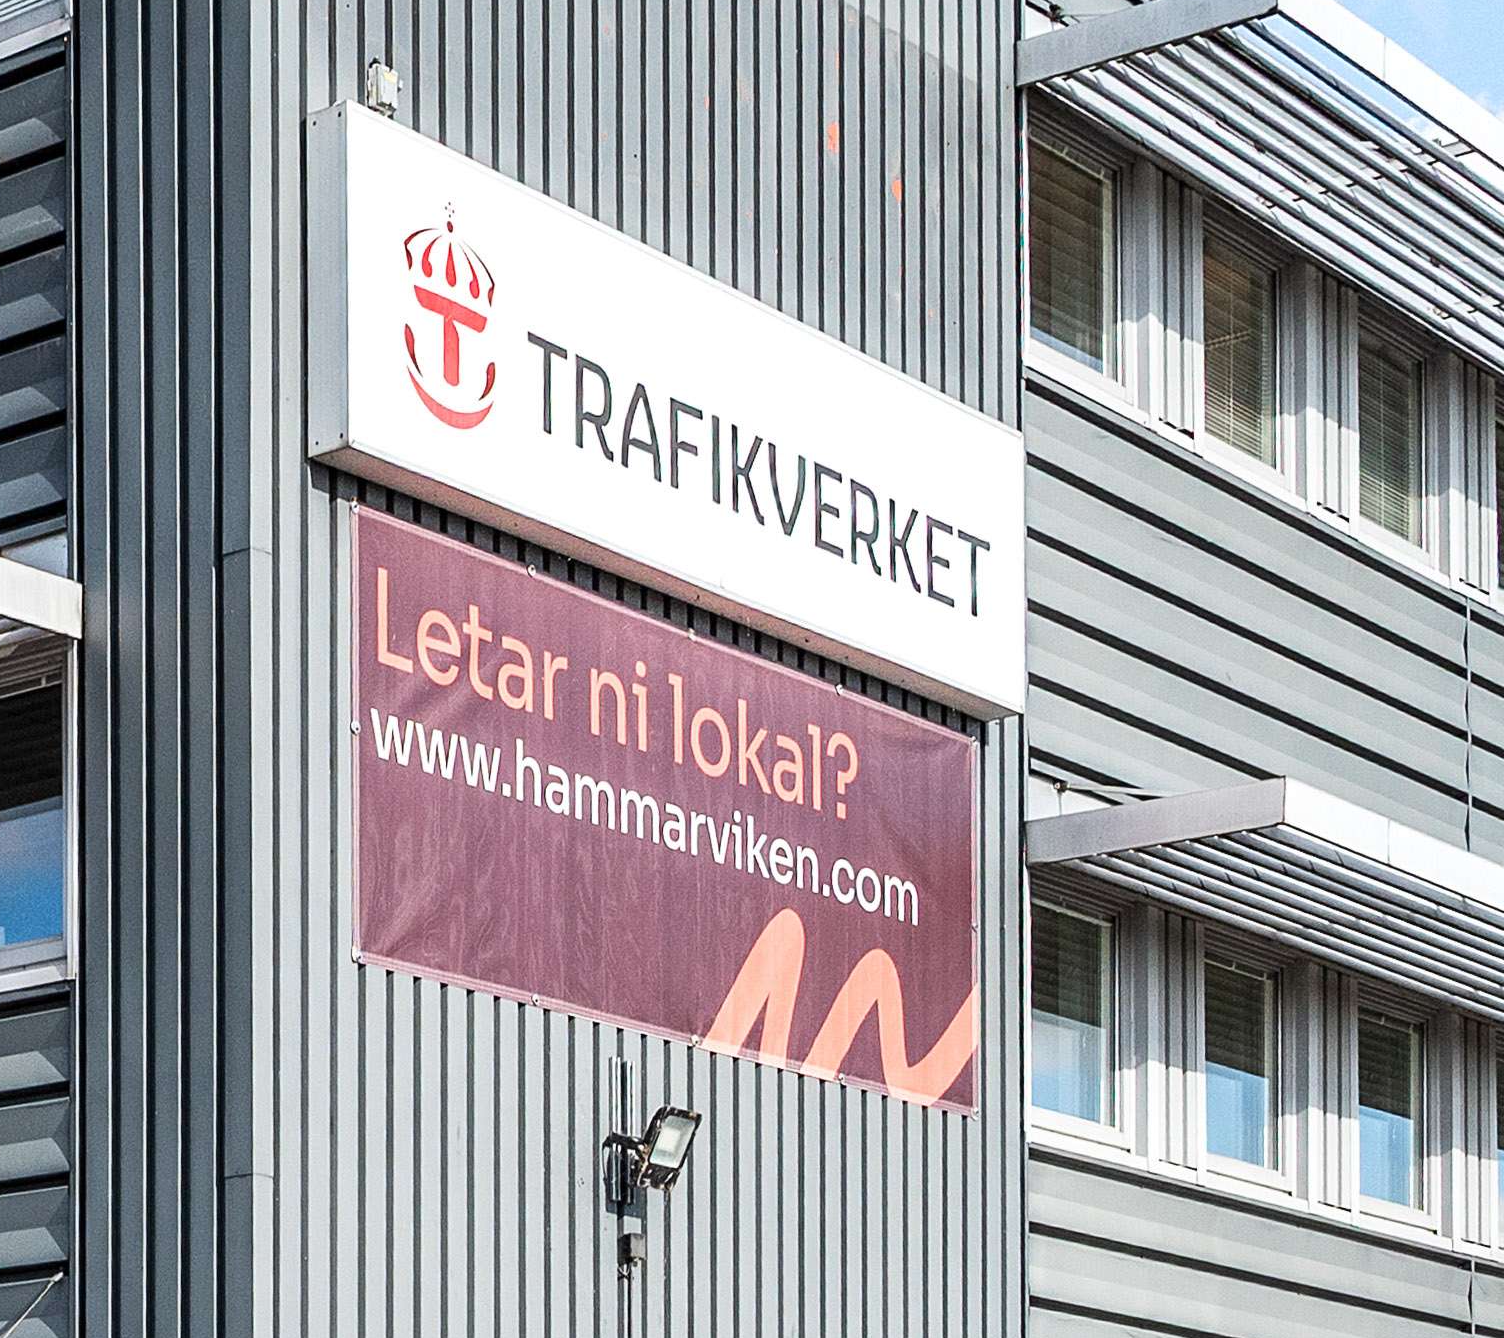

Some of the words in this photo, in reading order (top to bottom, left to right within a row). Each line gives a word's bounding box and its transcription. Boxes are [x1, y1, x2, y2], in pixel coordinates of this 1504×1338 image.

[527, 330, 991, 617] TRAFIKVERKET
[369, 707, 921, 927] www.hammarviken.com
[376, 566, 569, 721] Letar
[590, 661, 649, 753] ni
[667, 672, 860, 821] lokal?
